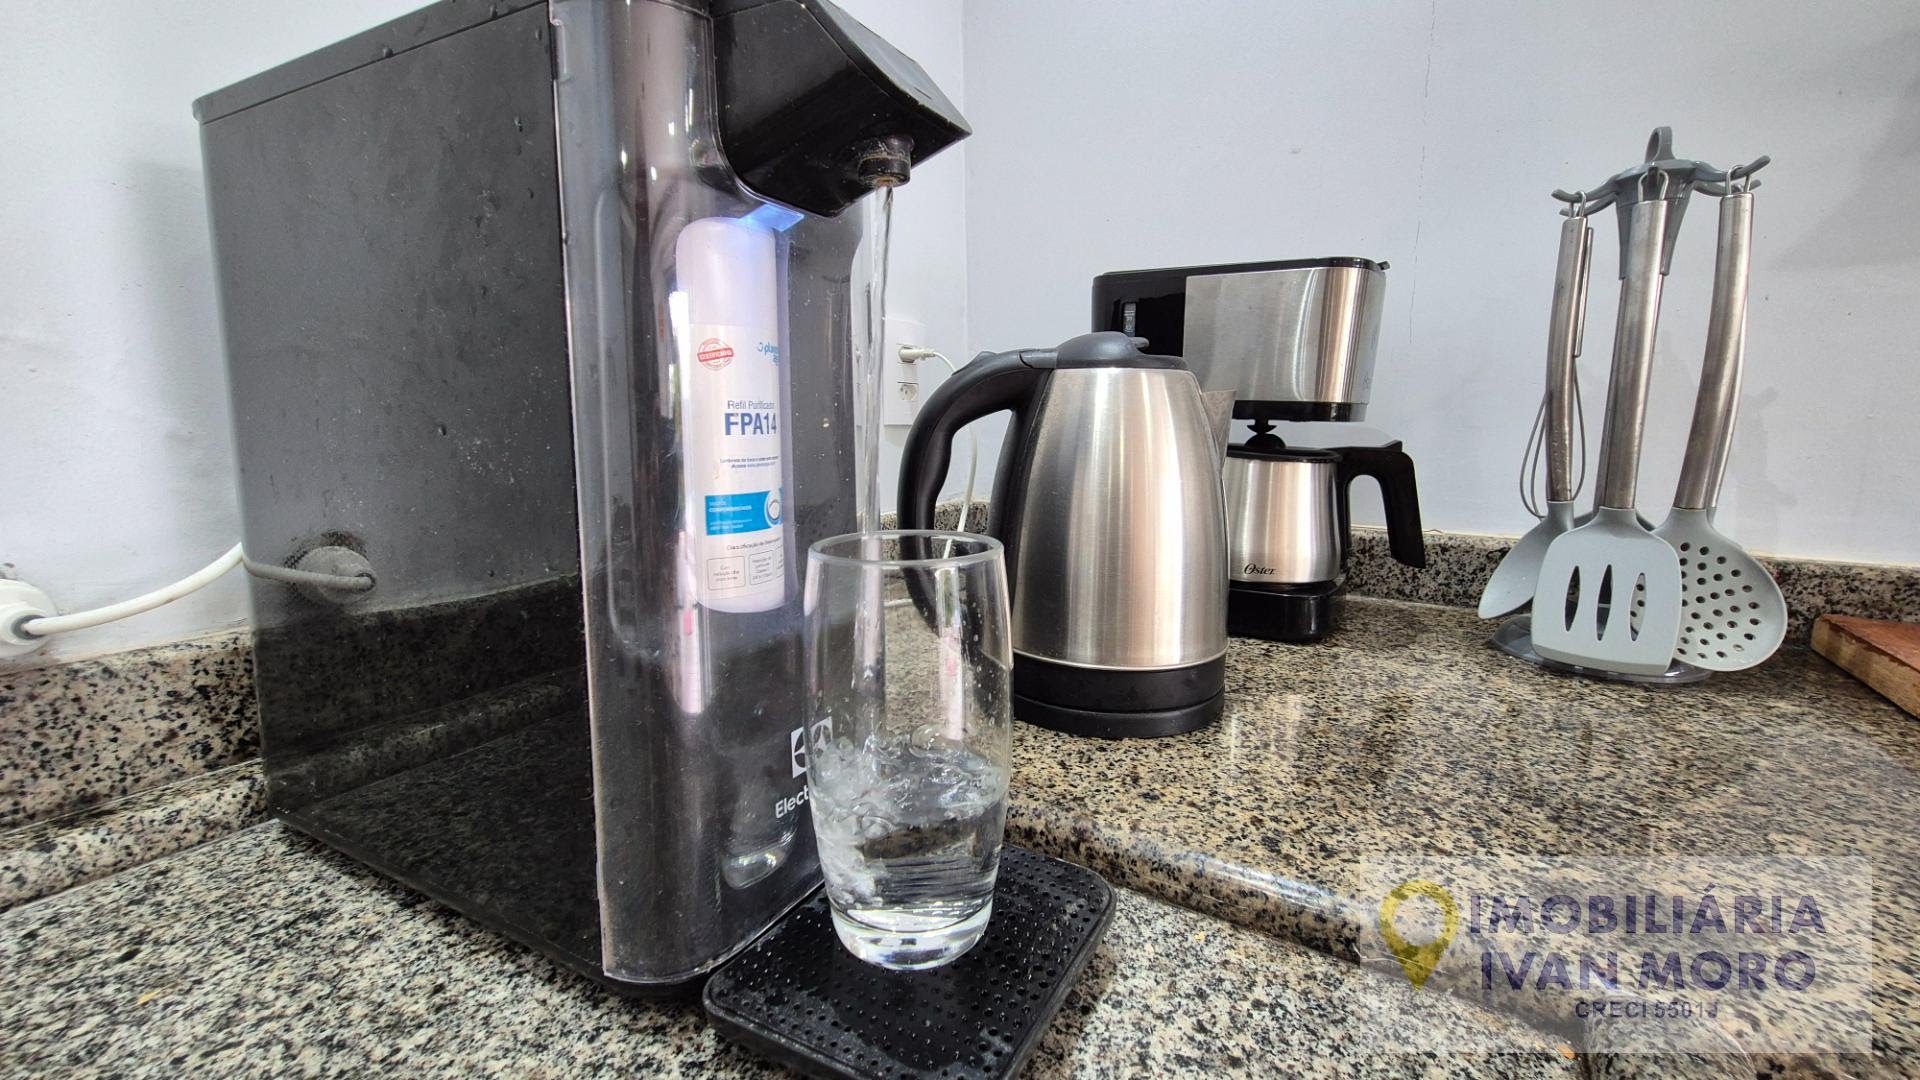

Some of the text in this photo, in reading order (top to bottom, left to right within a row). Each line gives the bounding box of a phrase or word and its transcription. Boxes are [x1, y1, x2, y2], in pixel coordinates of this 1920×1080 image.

[727, 400, 746, 410] Refil
[724, 412, 777, 436] FPA14
[1244, 563, 1277, 576] Oster
[775, 784, 809, 819] Elect
